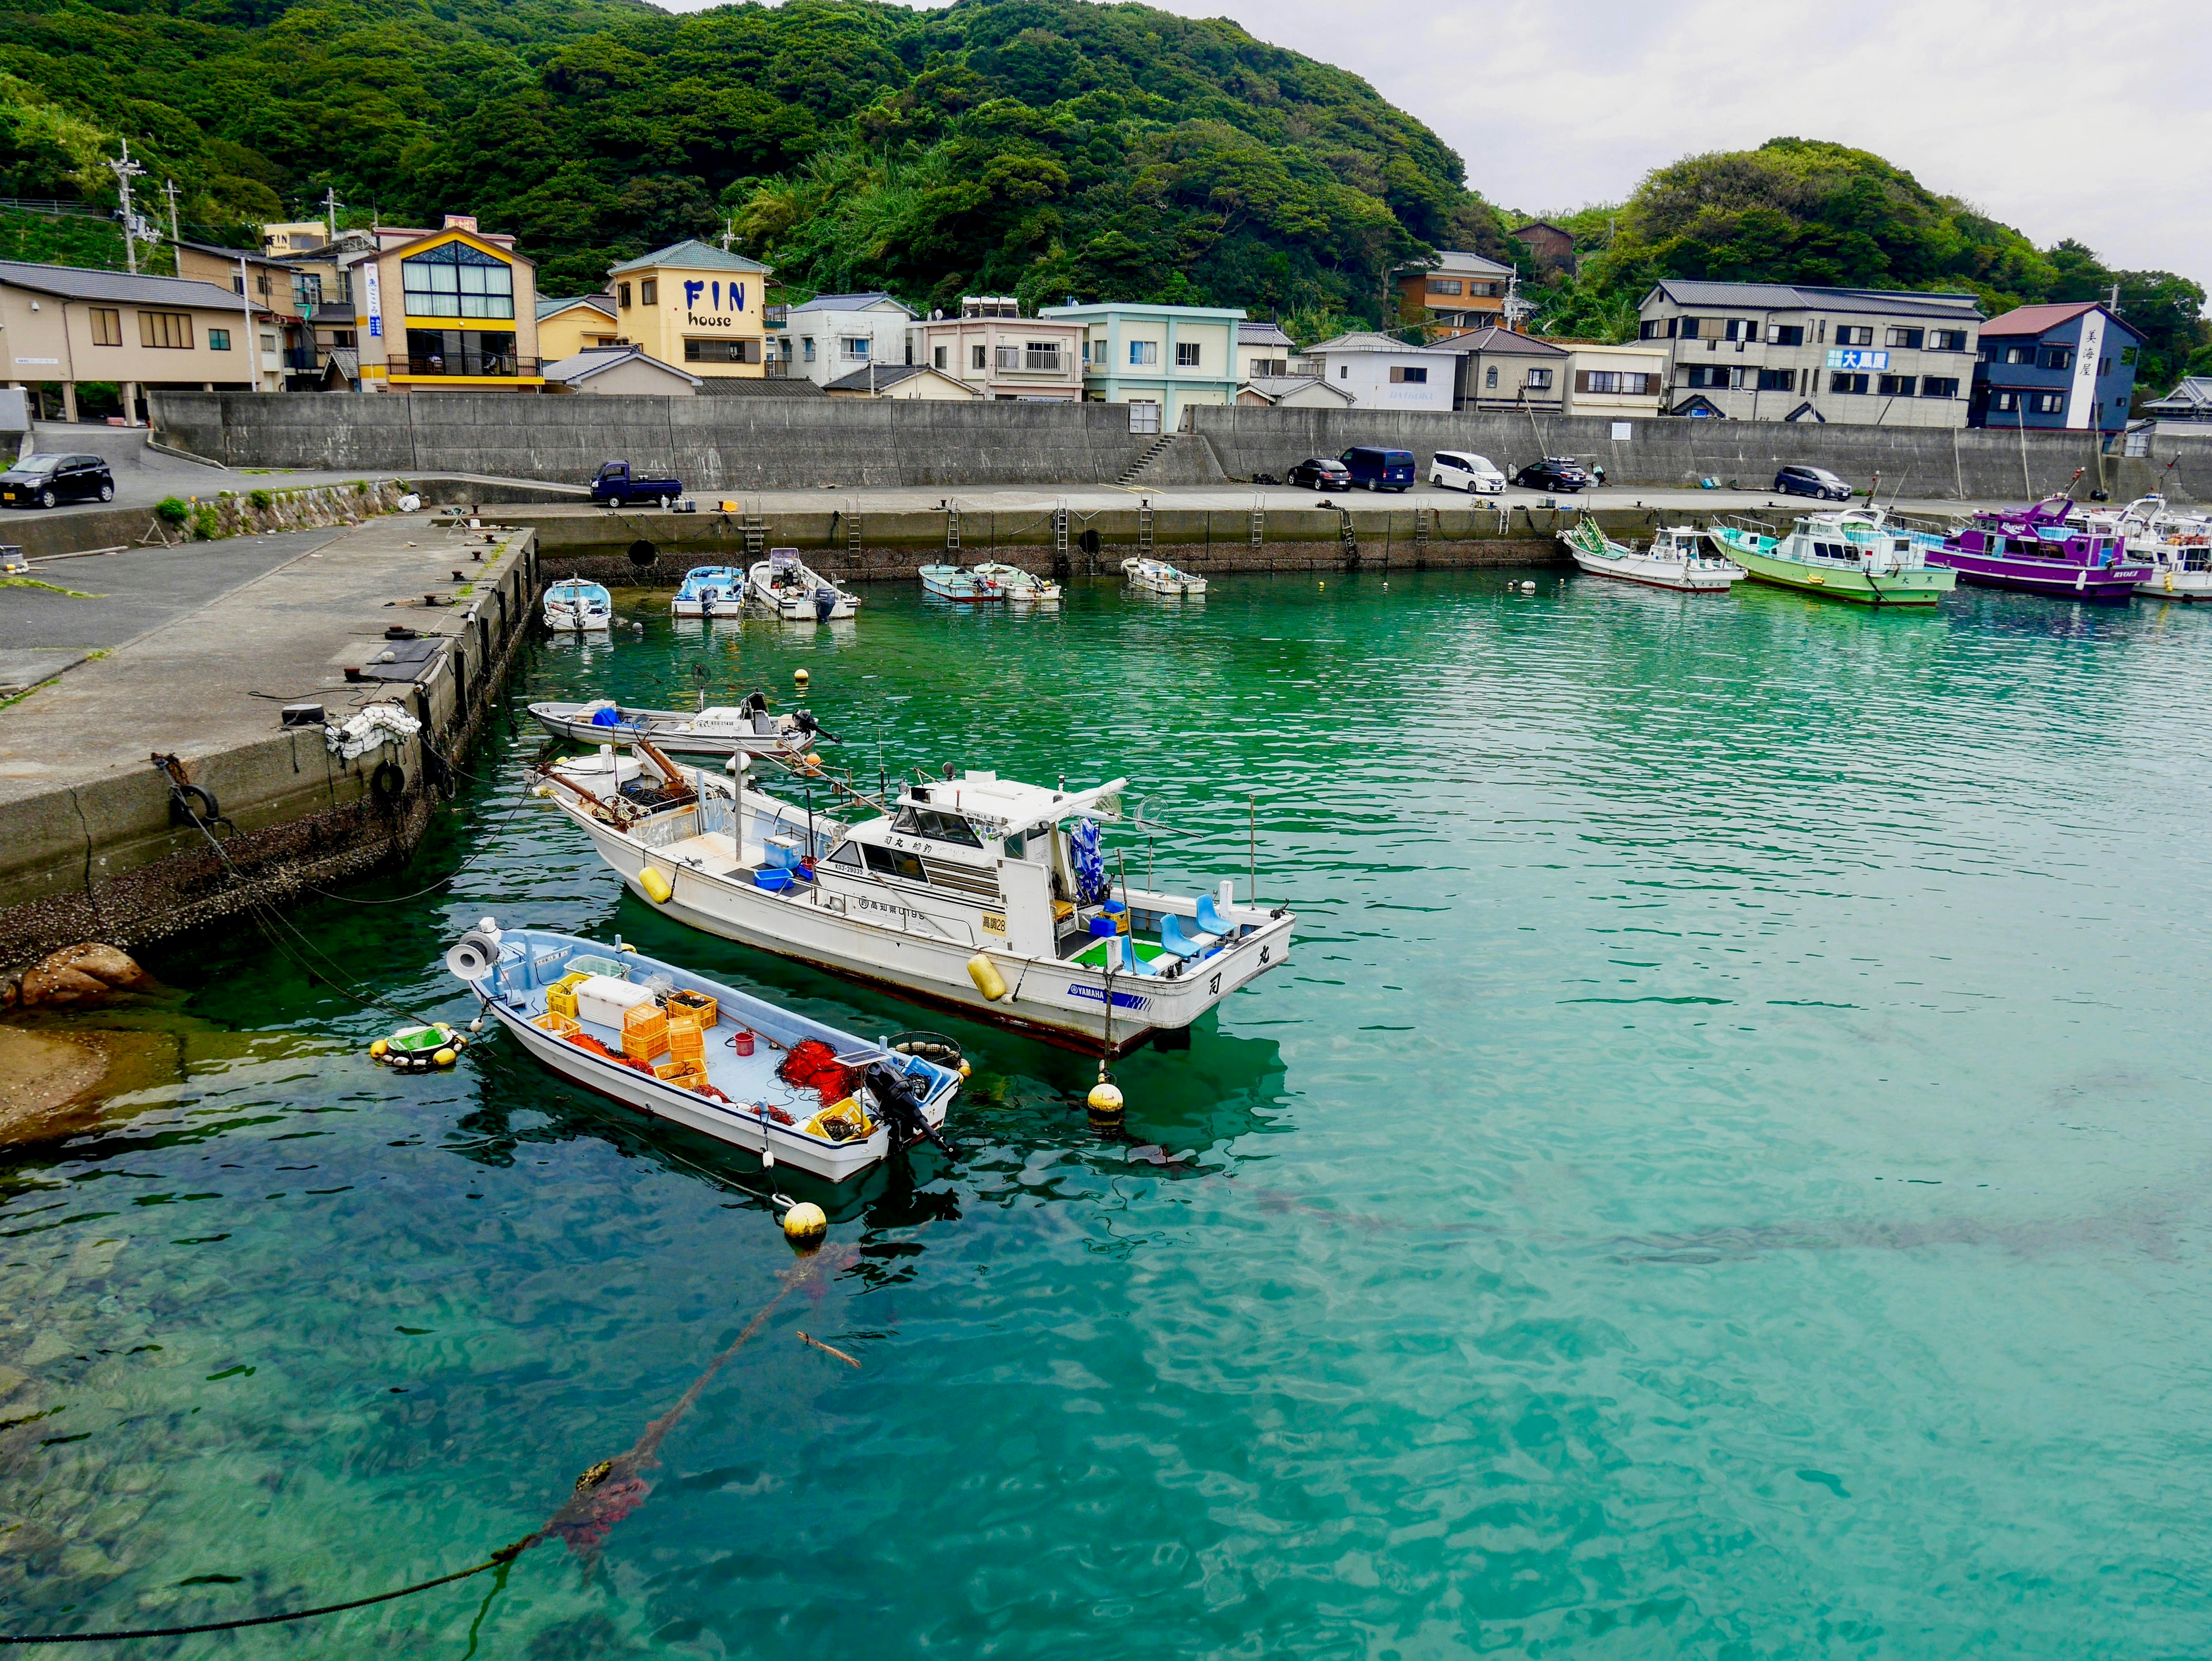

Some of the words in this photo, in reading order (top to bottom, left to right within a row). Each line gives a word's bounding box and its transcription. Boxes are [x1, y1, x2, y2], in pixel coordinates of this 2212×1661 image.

[684, 280, 745, 312] FIN
[688, 312, 731, 327] house
[1843, 351, 1886, 369] 大黒屋
[2079, 329, 2096, 376] 美海屋
[835, 864, 863, 875] K03-29035
[983, 916, 1005, 932] 高調28
[1078, 987, 1104, 999] YAMAHA
